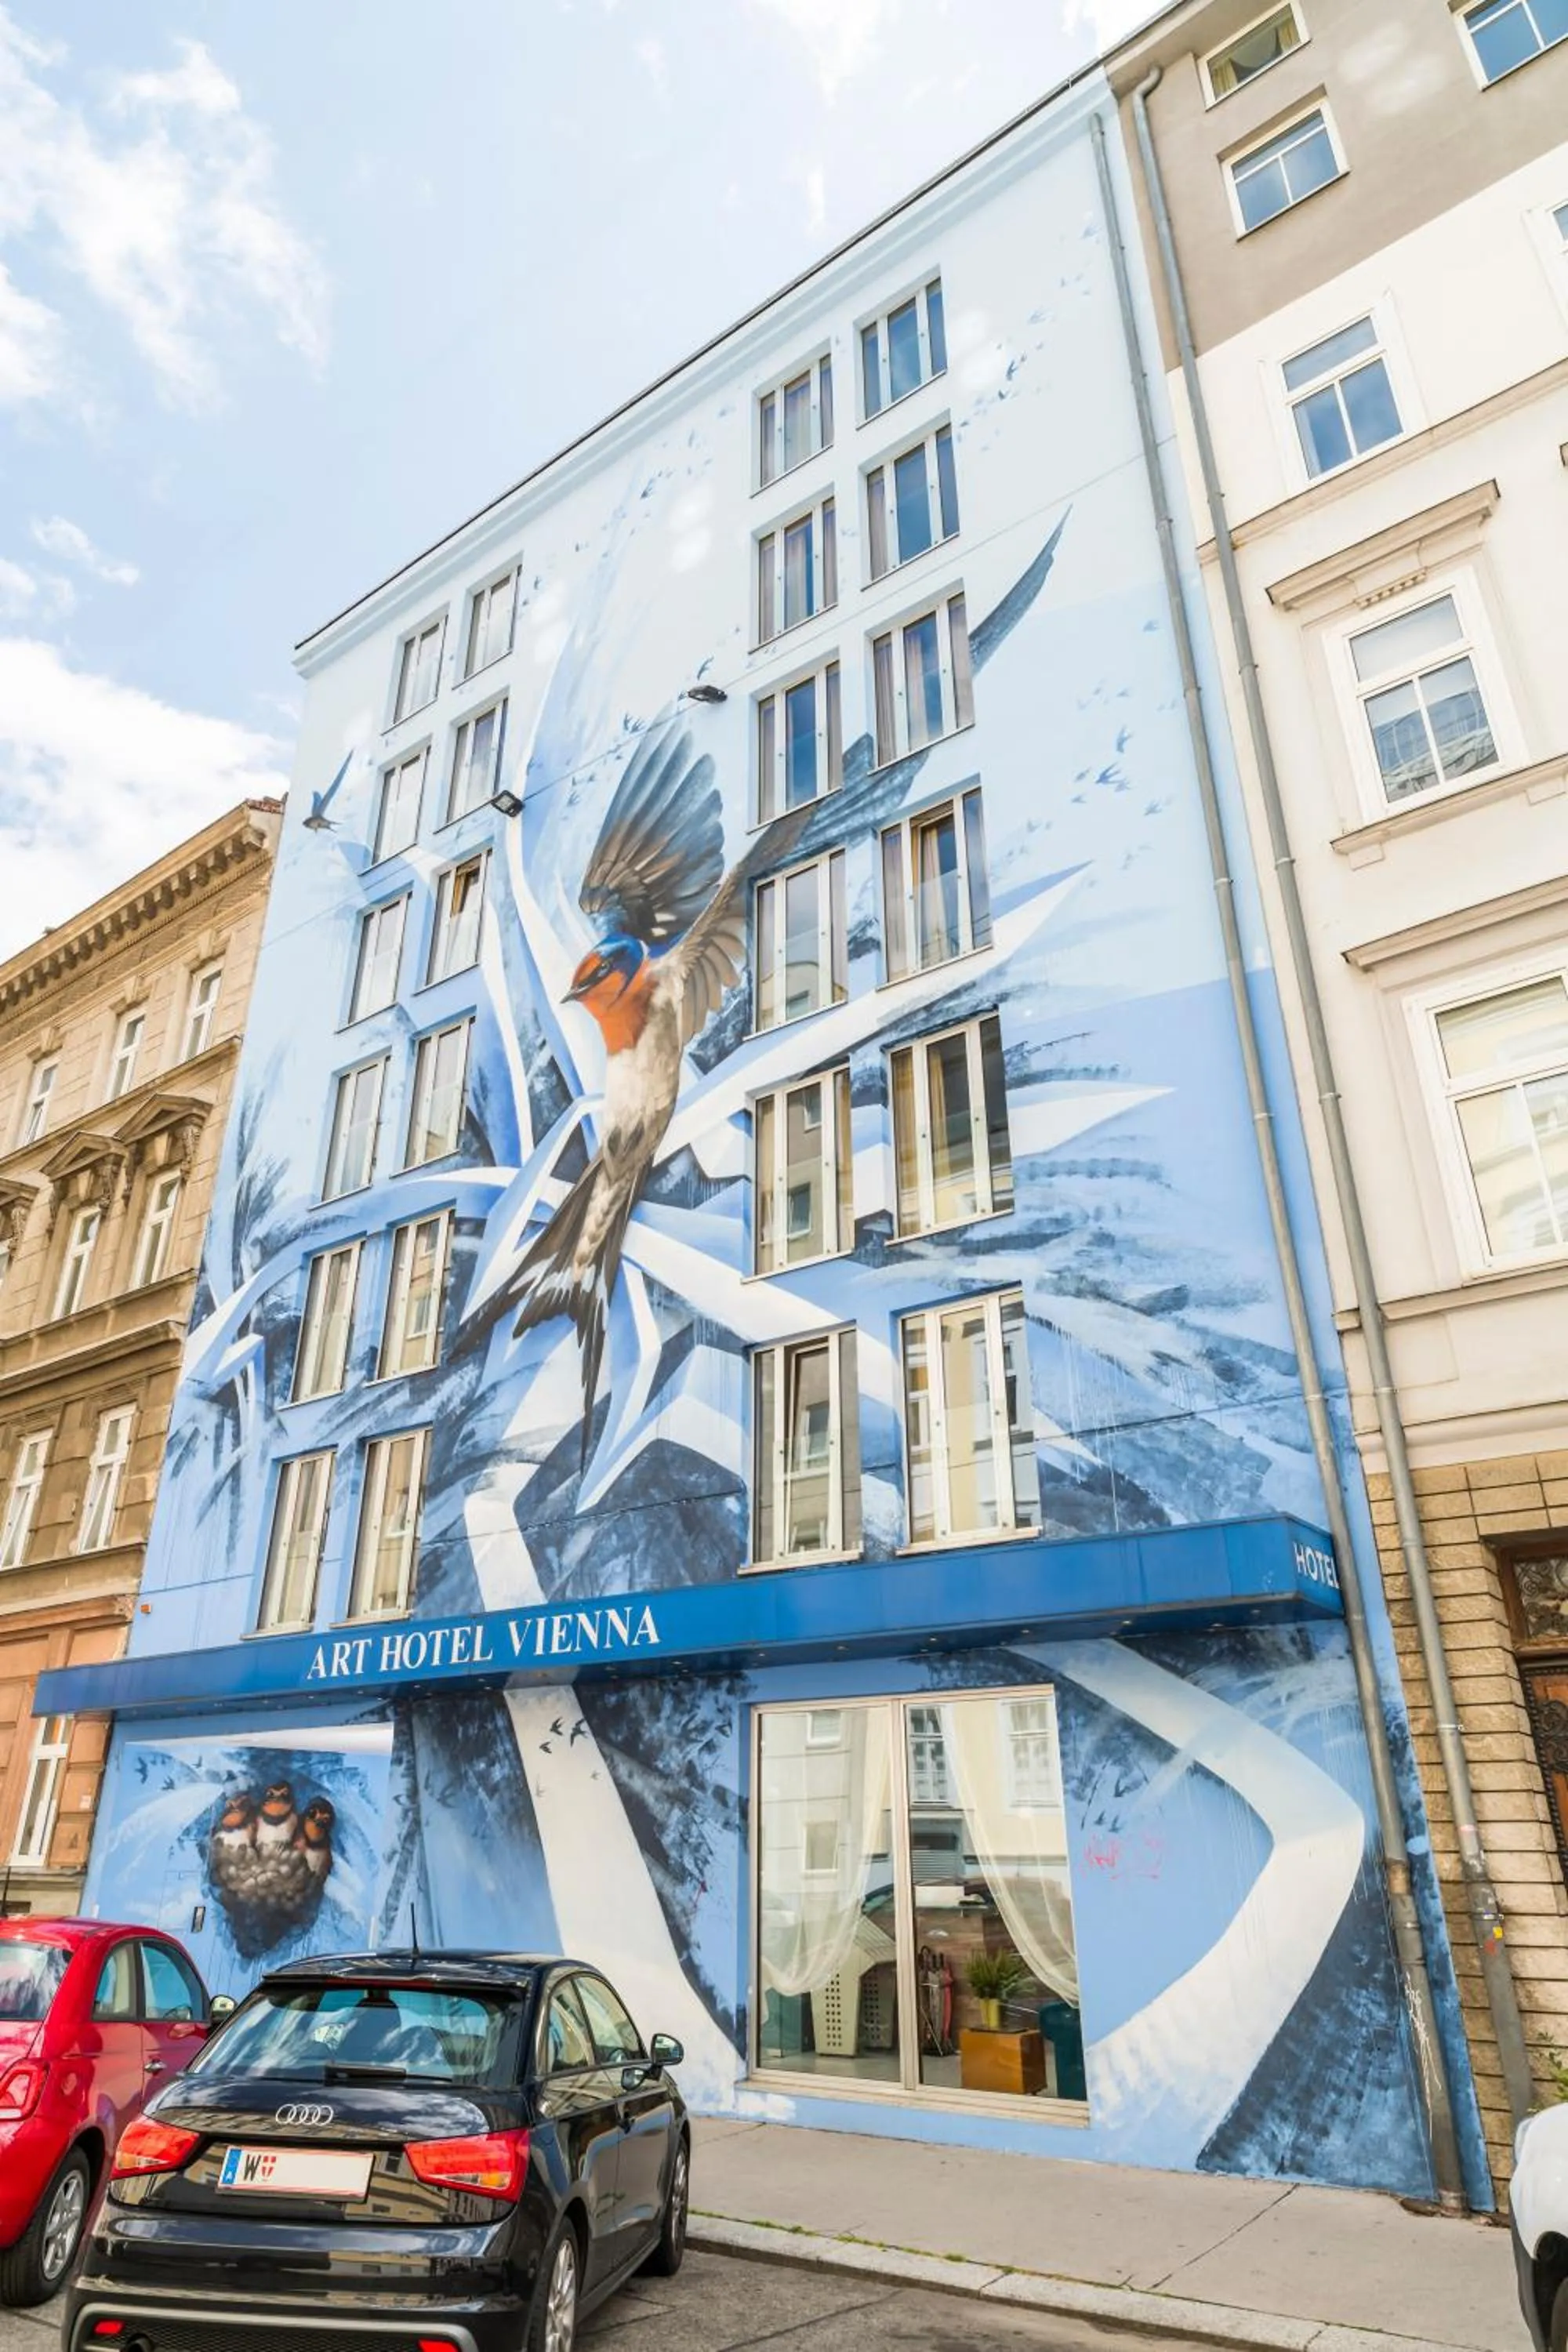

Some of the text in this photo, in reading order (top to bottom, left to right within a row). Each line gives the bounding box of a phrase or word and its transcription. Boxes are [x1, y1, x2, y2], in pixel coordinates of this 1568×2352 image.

[1292, 1541, 1339, 1589] HOTEL
[307, 1605, 660, 1679] ART HOTEL VIENNA
[243, 2154, 262, 2181] W
